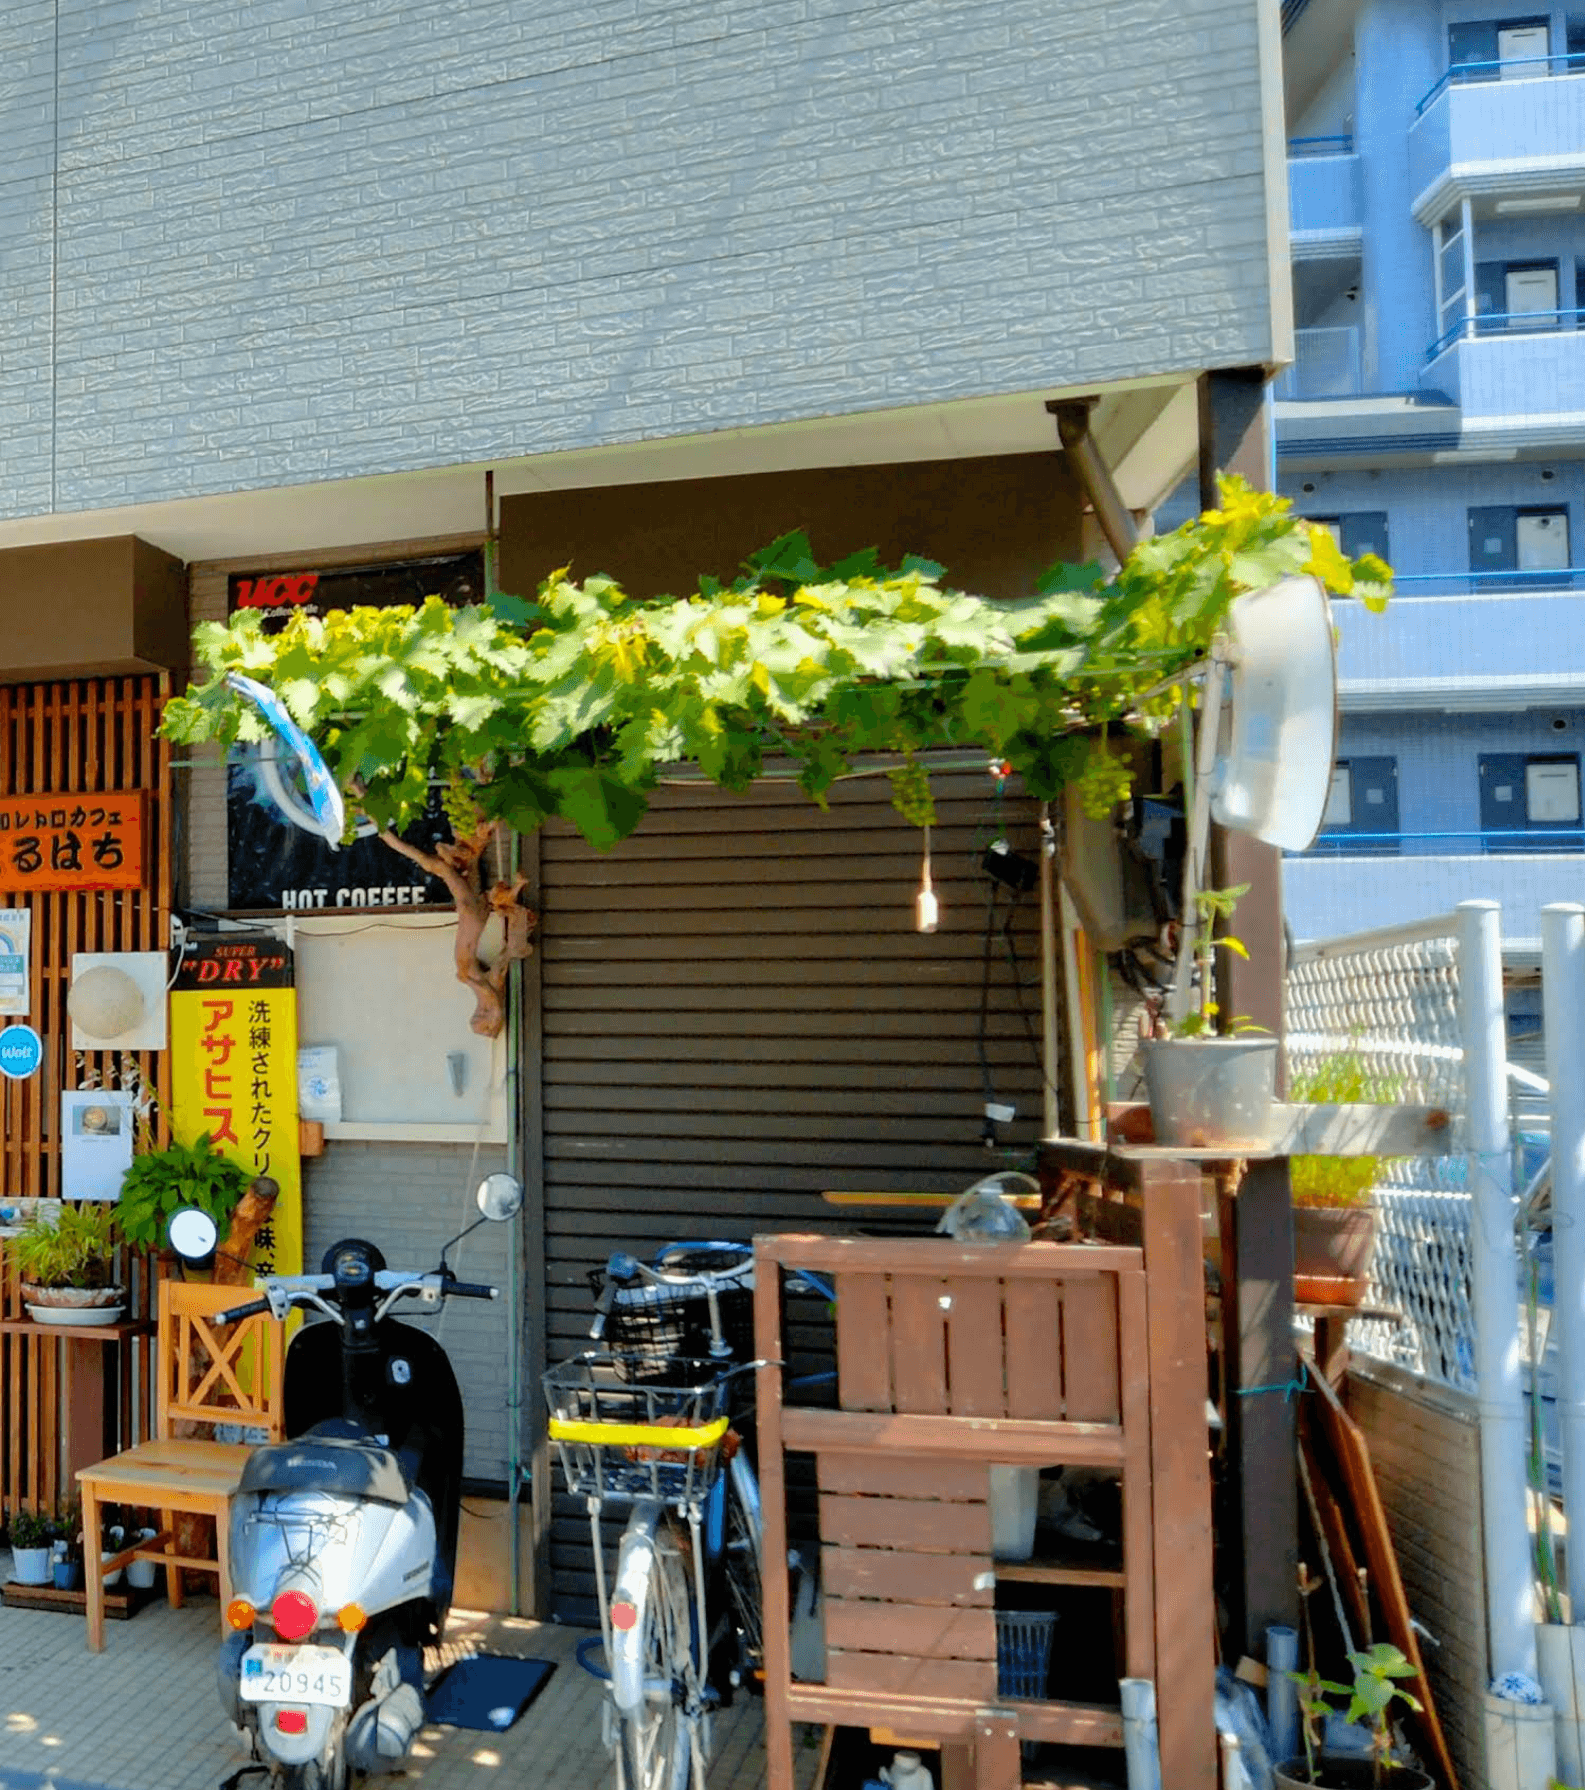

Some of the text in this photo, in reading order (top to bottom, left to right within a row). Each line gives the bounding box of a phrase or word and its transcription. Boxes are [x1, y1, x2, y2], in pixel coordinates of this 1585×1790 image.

[237, 574, 319, 607] UCC
[282, 886, 426, 909] HOT COFFEE
[263, 1670, 342, 1698] 20945
